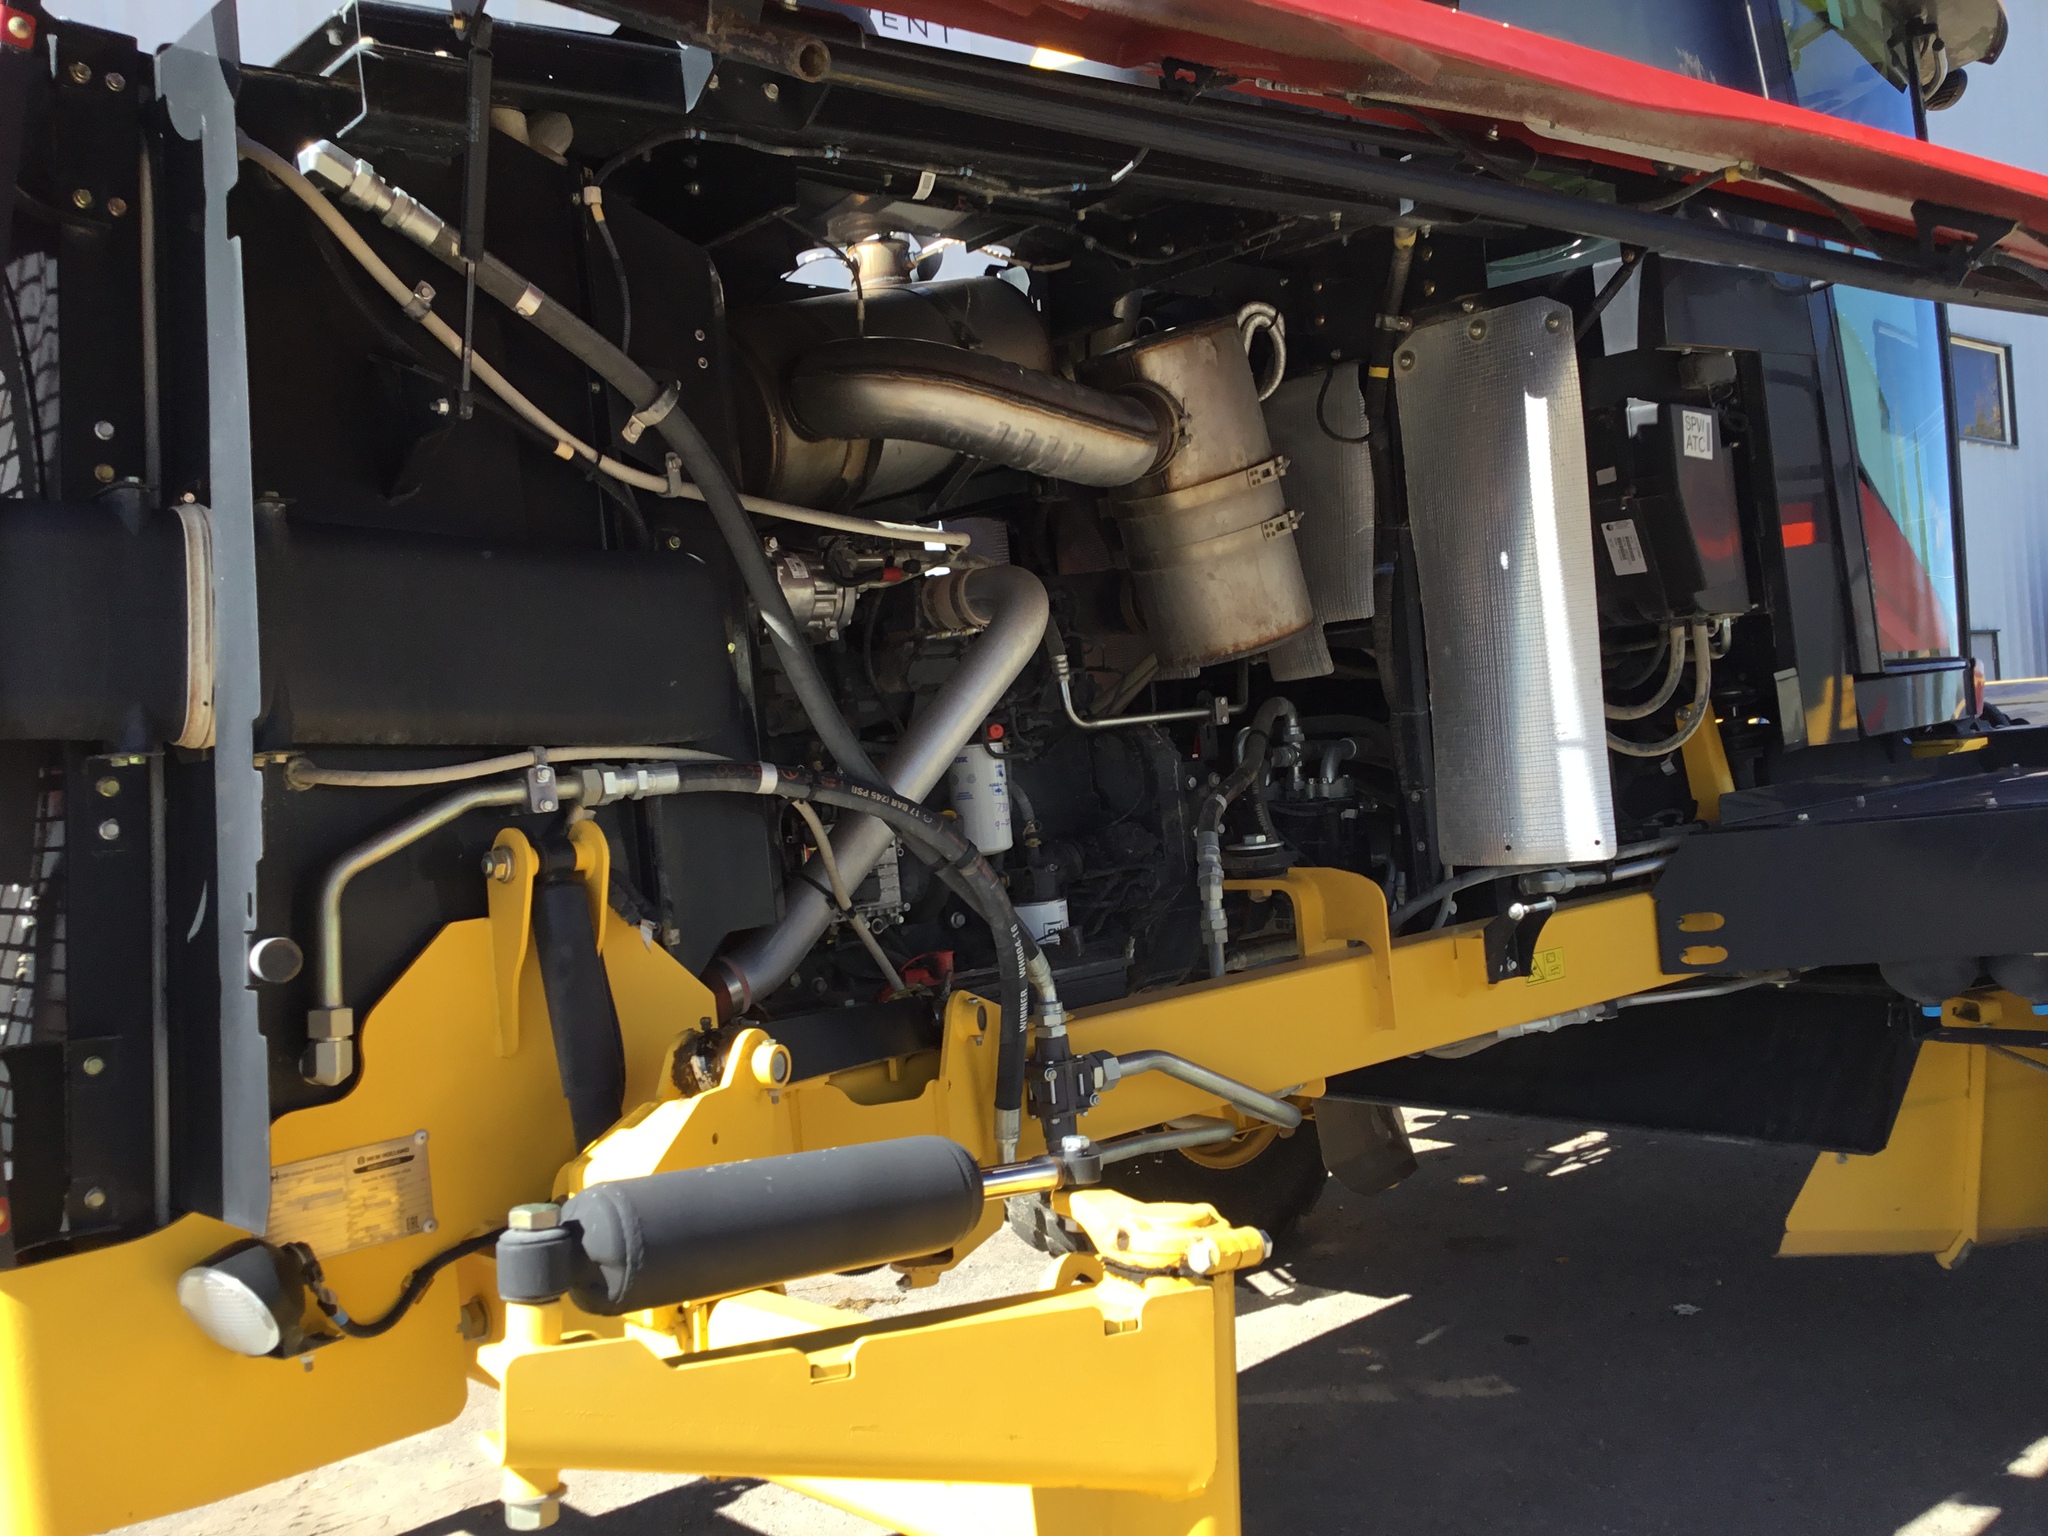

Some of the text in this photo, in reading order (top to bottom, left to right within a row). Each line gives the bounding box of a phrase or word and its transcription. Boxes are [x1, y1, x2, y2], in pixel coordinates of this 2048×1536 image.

[868, 9, 954, 44] ENT
[1686, 434, 1706, 453] ATC
[890, 798, 909, 811] BAR
[1010, 923, 1029, 1033] WINNER WH004-16
